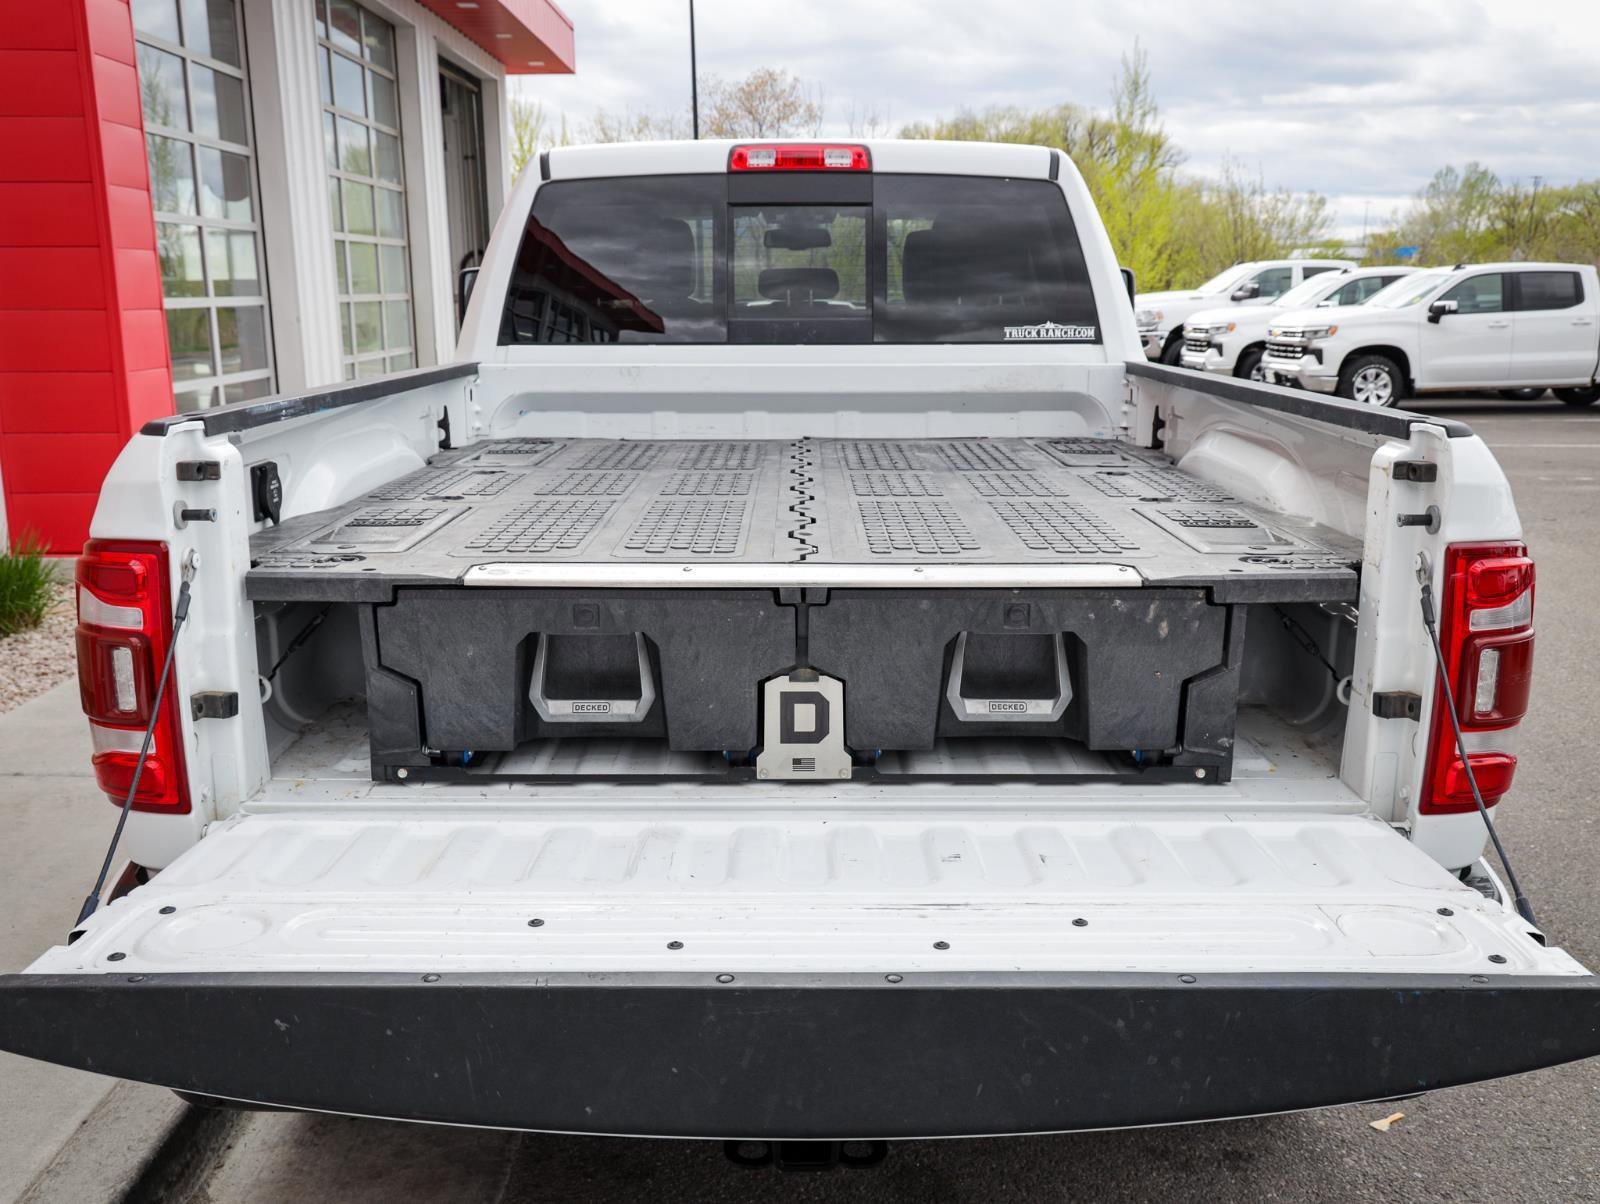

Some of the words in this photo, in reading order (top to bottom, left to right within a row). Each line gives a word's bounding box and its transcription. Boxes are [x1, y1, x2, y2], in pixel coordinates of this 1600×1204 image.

[1004, 327, 1038, 338] TRUCK
[1040, 327, 1095, 338] RANCH.COM
[991, 703, 1025, 711] DECKED
[780, 691, 830, 744] D
